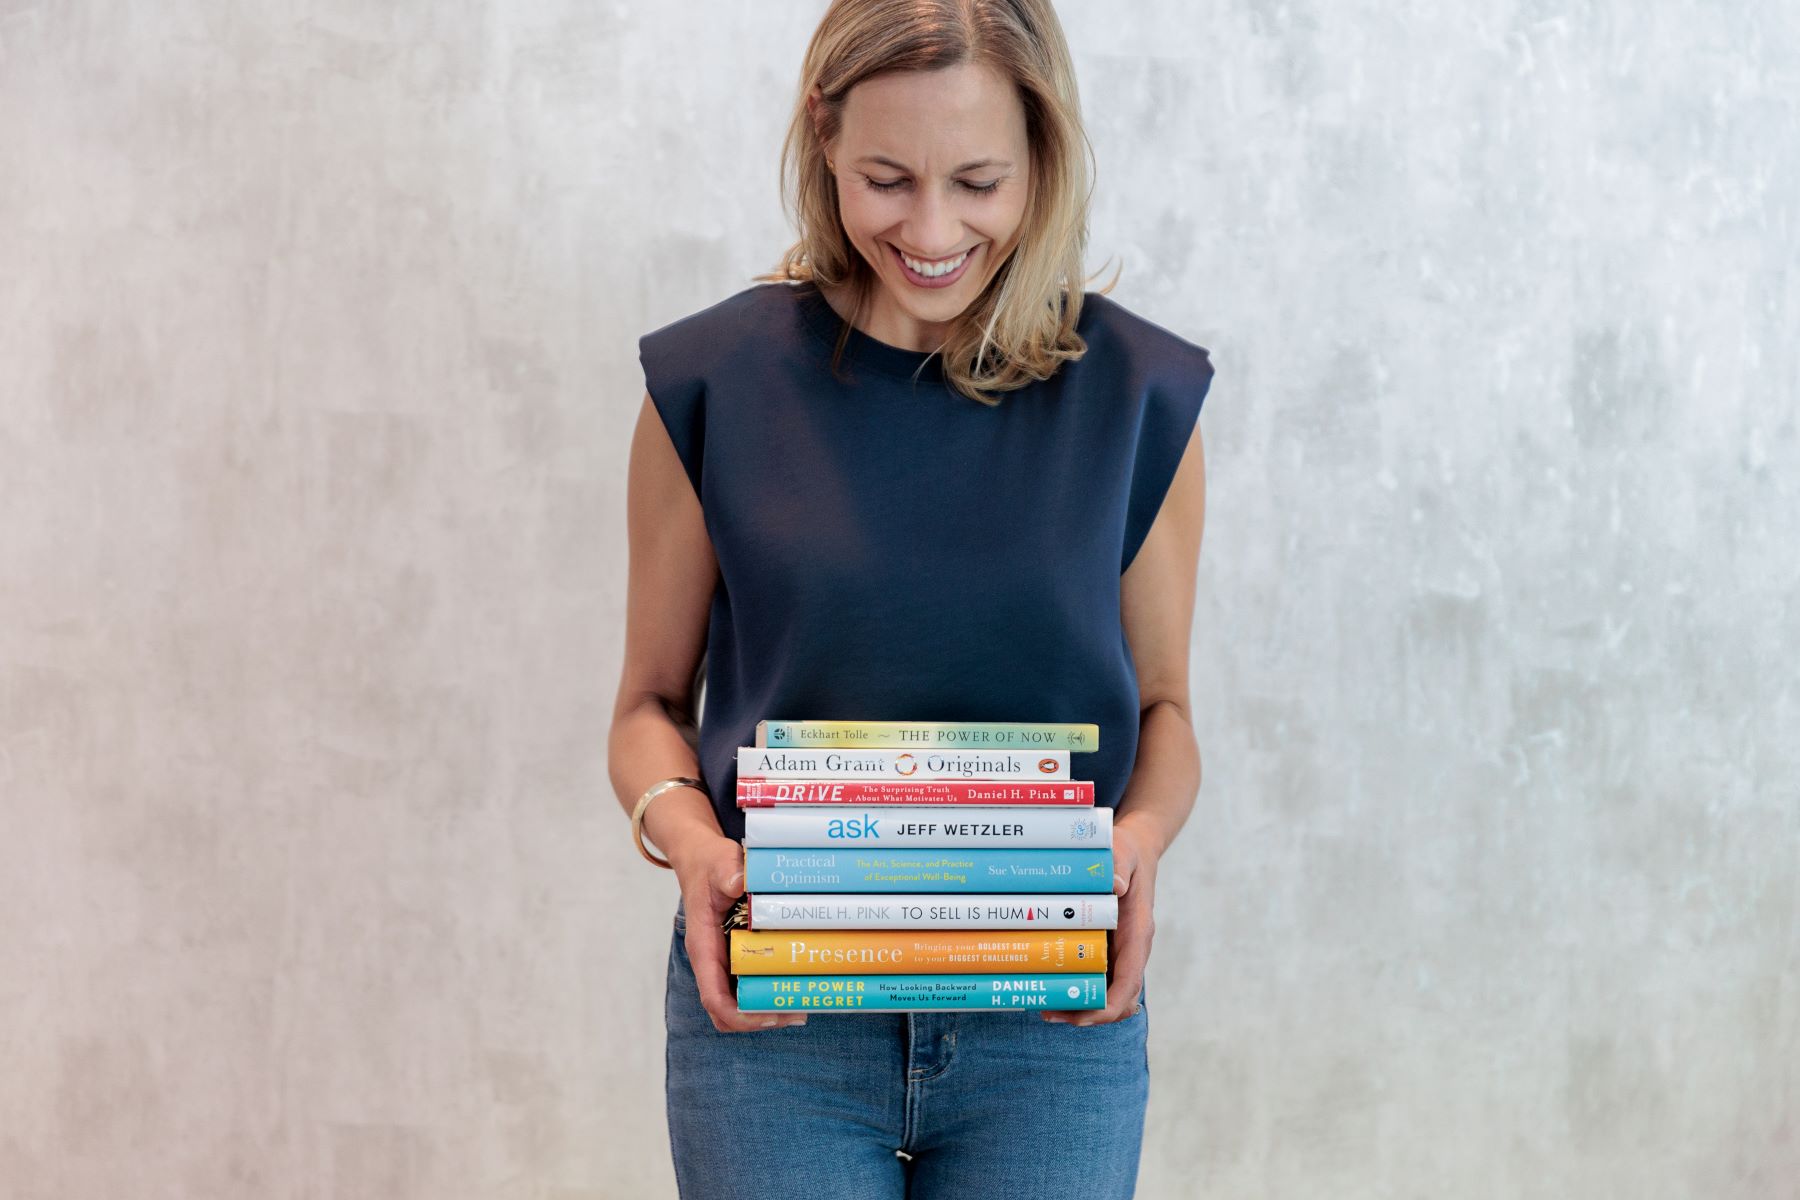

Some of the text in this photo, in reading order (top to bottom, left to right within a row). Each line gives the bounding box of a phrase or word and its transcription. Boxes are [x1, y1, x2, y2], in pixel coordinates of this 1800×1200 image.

[801, 729, 839, 739] Eckhart
[844, 729, 868, 739] Tolle
[899, 730, 1056, 743] THE POWER OF NOW
[758, 754, 885, 771] Adam Grant
[927, 755, 1021, 778] Originals
[881, 786, 924, 795] Surprising
[968, 789, 1057, 799] Daniel H. Pink
[827, 813, 879, 839] ask
[897, 824, 1024, 836] JEFF WETZLER
[776, 854, 836, 868] Practical
[856, 860, 870, 868] The
[925, 860, 941, 868] and
[942, 860, 974, 868] Practice
[988, 865, 1072, 876] Sue Varma, MD
[771, 871, 840, 887] Optimism
[864, 873, 873, 881] of
[874, 873, 920, 884] Exceptional
[781, 906, 890, 920] DANIEL H. PINK
[901, 906, 923, 920] TO
[930, 907, 961, 920] SELL
[968, 907, 980, 920] IS
[789, 941, 903, 963] Presence
[914, 942, 1030, 952] Bringing your BOLDEST SELF
[926, 956, 946, 964] your
[949, 954, 980, 962] BIGGEST
[982, 954, 1029, 962] CHALLENGES
[772, 981, 865, 992] THE POWER
[900, 983, 933, 993] Looking
[936, 983, 977, 991] Backward
[992, 980, 1047, 991] DANIEL
[774, 996, 864, 1007] OF REGRET
[992, 995, 1047, 1005] H. PINK
